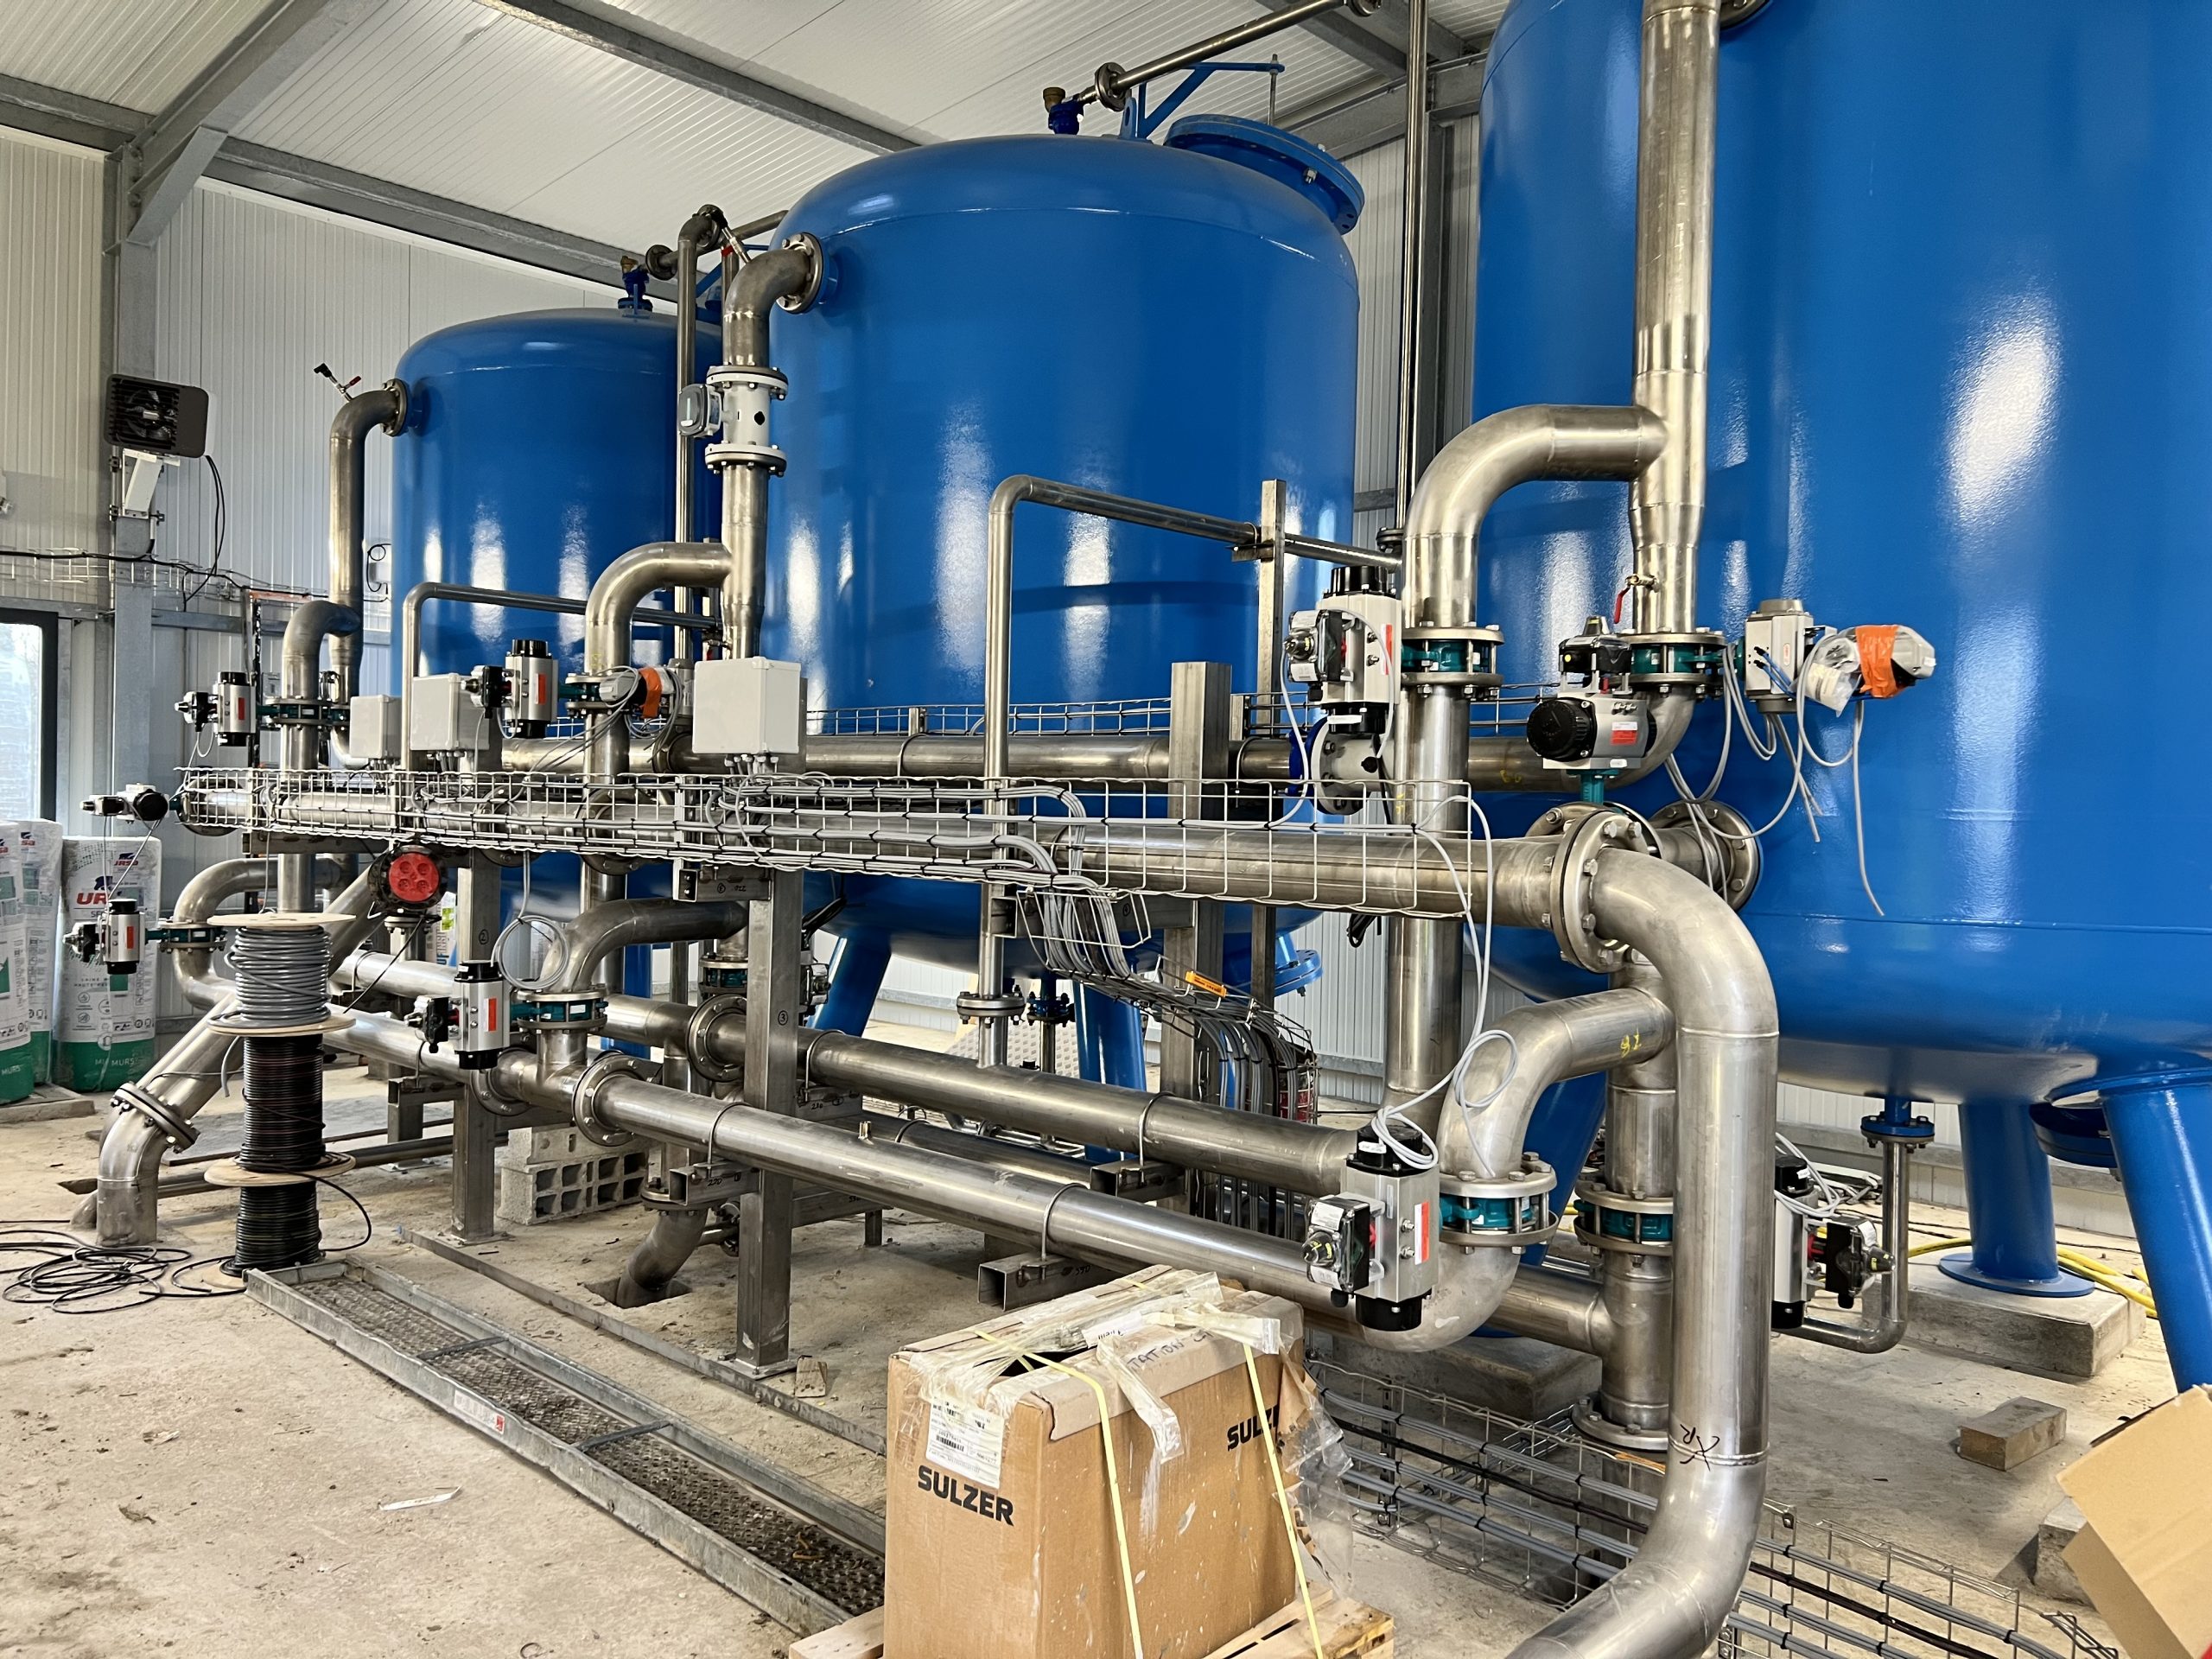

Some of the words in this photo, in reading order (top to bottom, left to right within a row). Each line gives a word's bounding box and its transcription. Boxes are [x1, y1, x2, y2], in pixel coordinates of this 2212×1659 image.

[77, 893, 109, 906] UR
[1126, 1340, 1185, 1370] TATION
[1227, 1404, 1280, 1452] SUL
[918, 1465, 1014, 1527] SULZER
